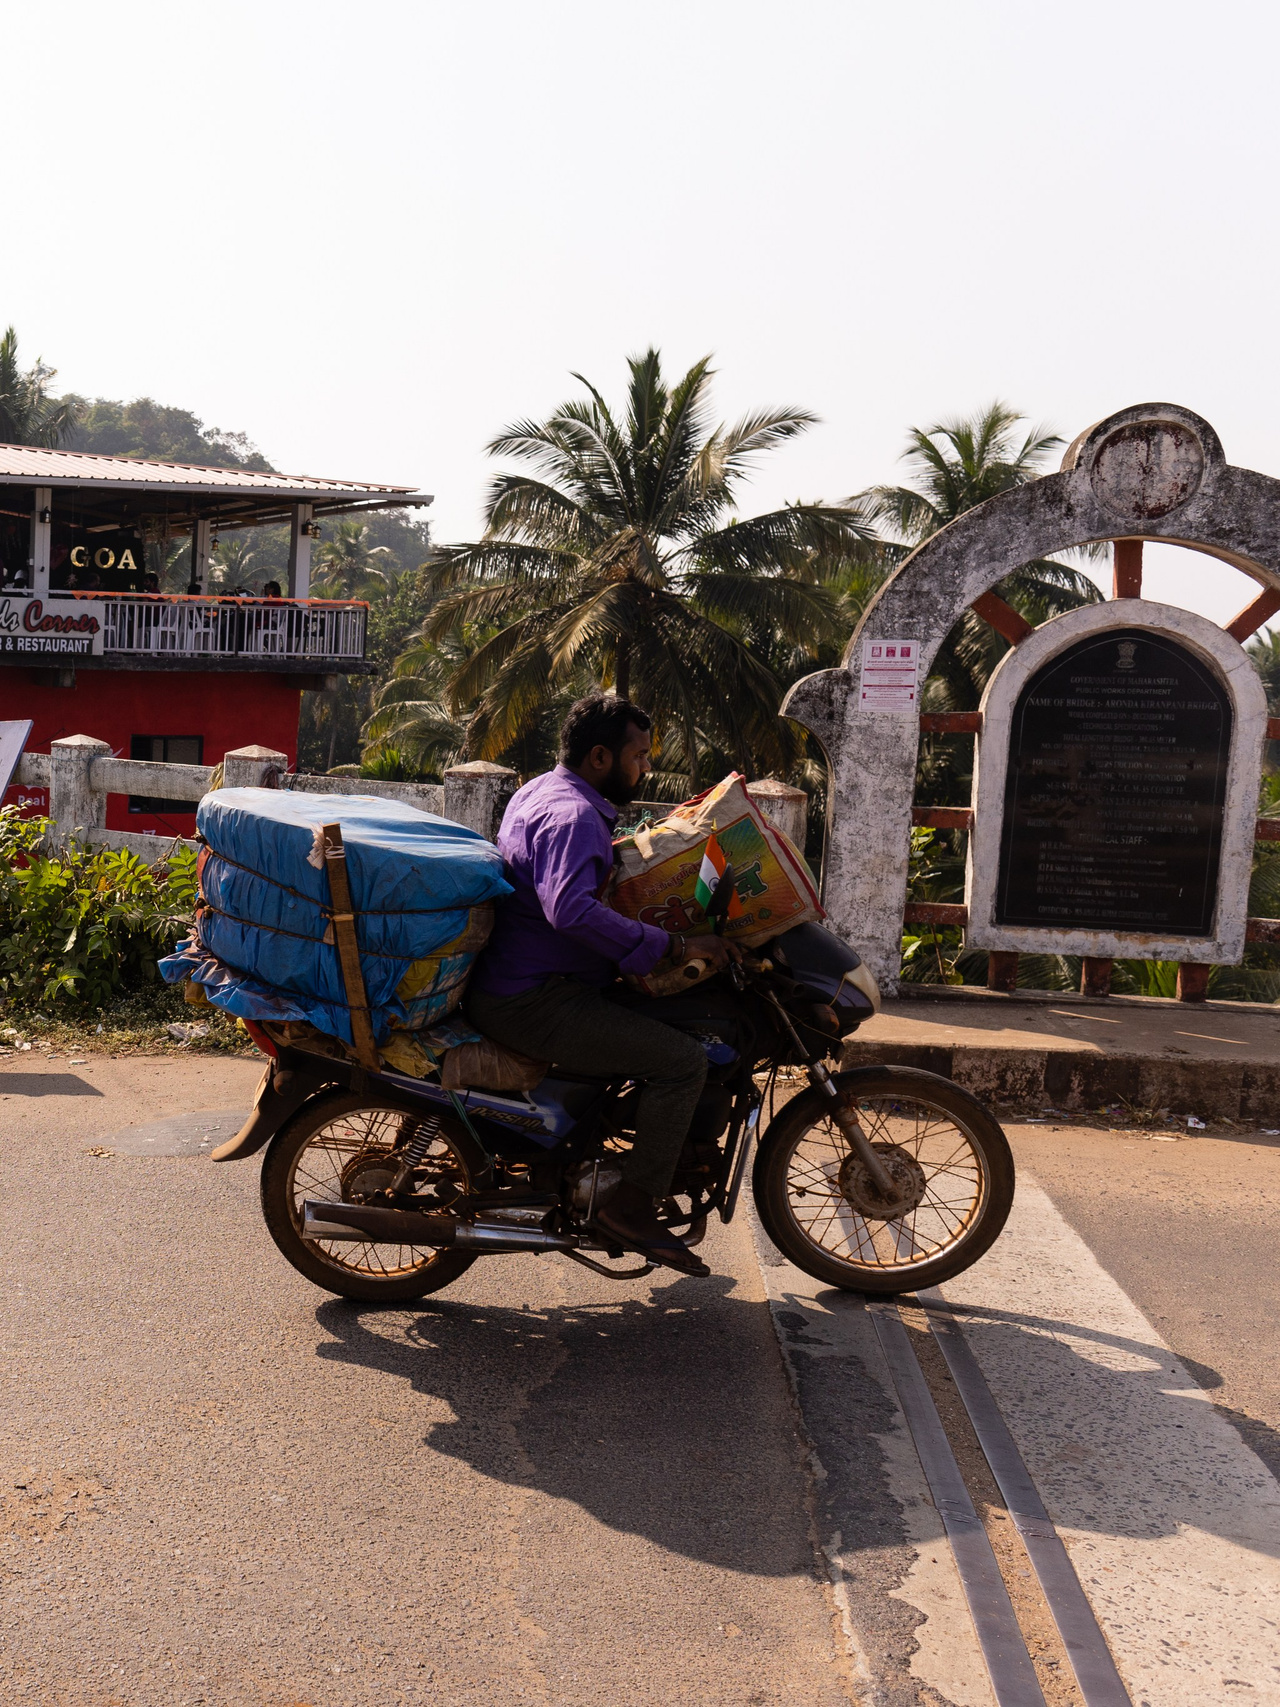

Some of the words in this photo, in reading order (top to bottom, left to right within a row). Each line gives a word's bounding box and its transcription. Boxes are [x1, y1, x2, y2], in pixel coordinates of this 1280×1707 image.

[70, 546, 138, 569] GOA
[23, 600, 101, 634] Corner
[6, 639, 14, 651] &
[17, 639, 89, 653] RESTAURANT
[1126, 688, 1172, 696] DEPARTMENT
[1029, 697, 1052, 706] NAME
[1053, 698, 1065, 707] OF
[1066, 699, 1096, 708] BRIDGE
[1105, 700, 1139, 709] ARONDA
[1120, 836, 1142, 845] STAFF
